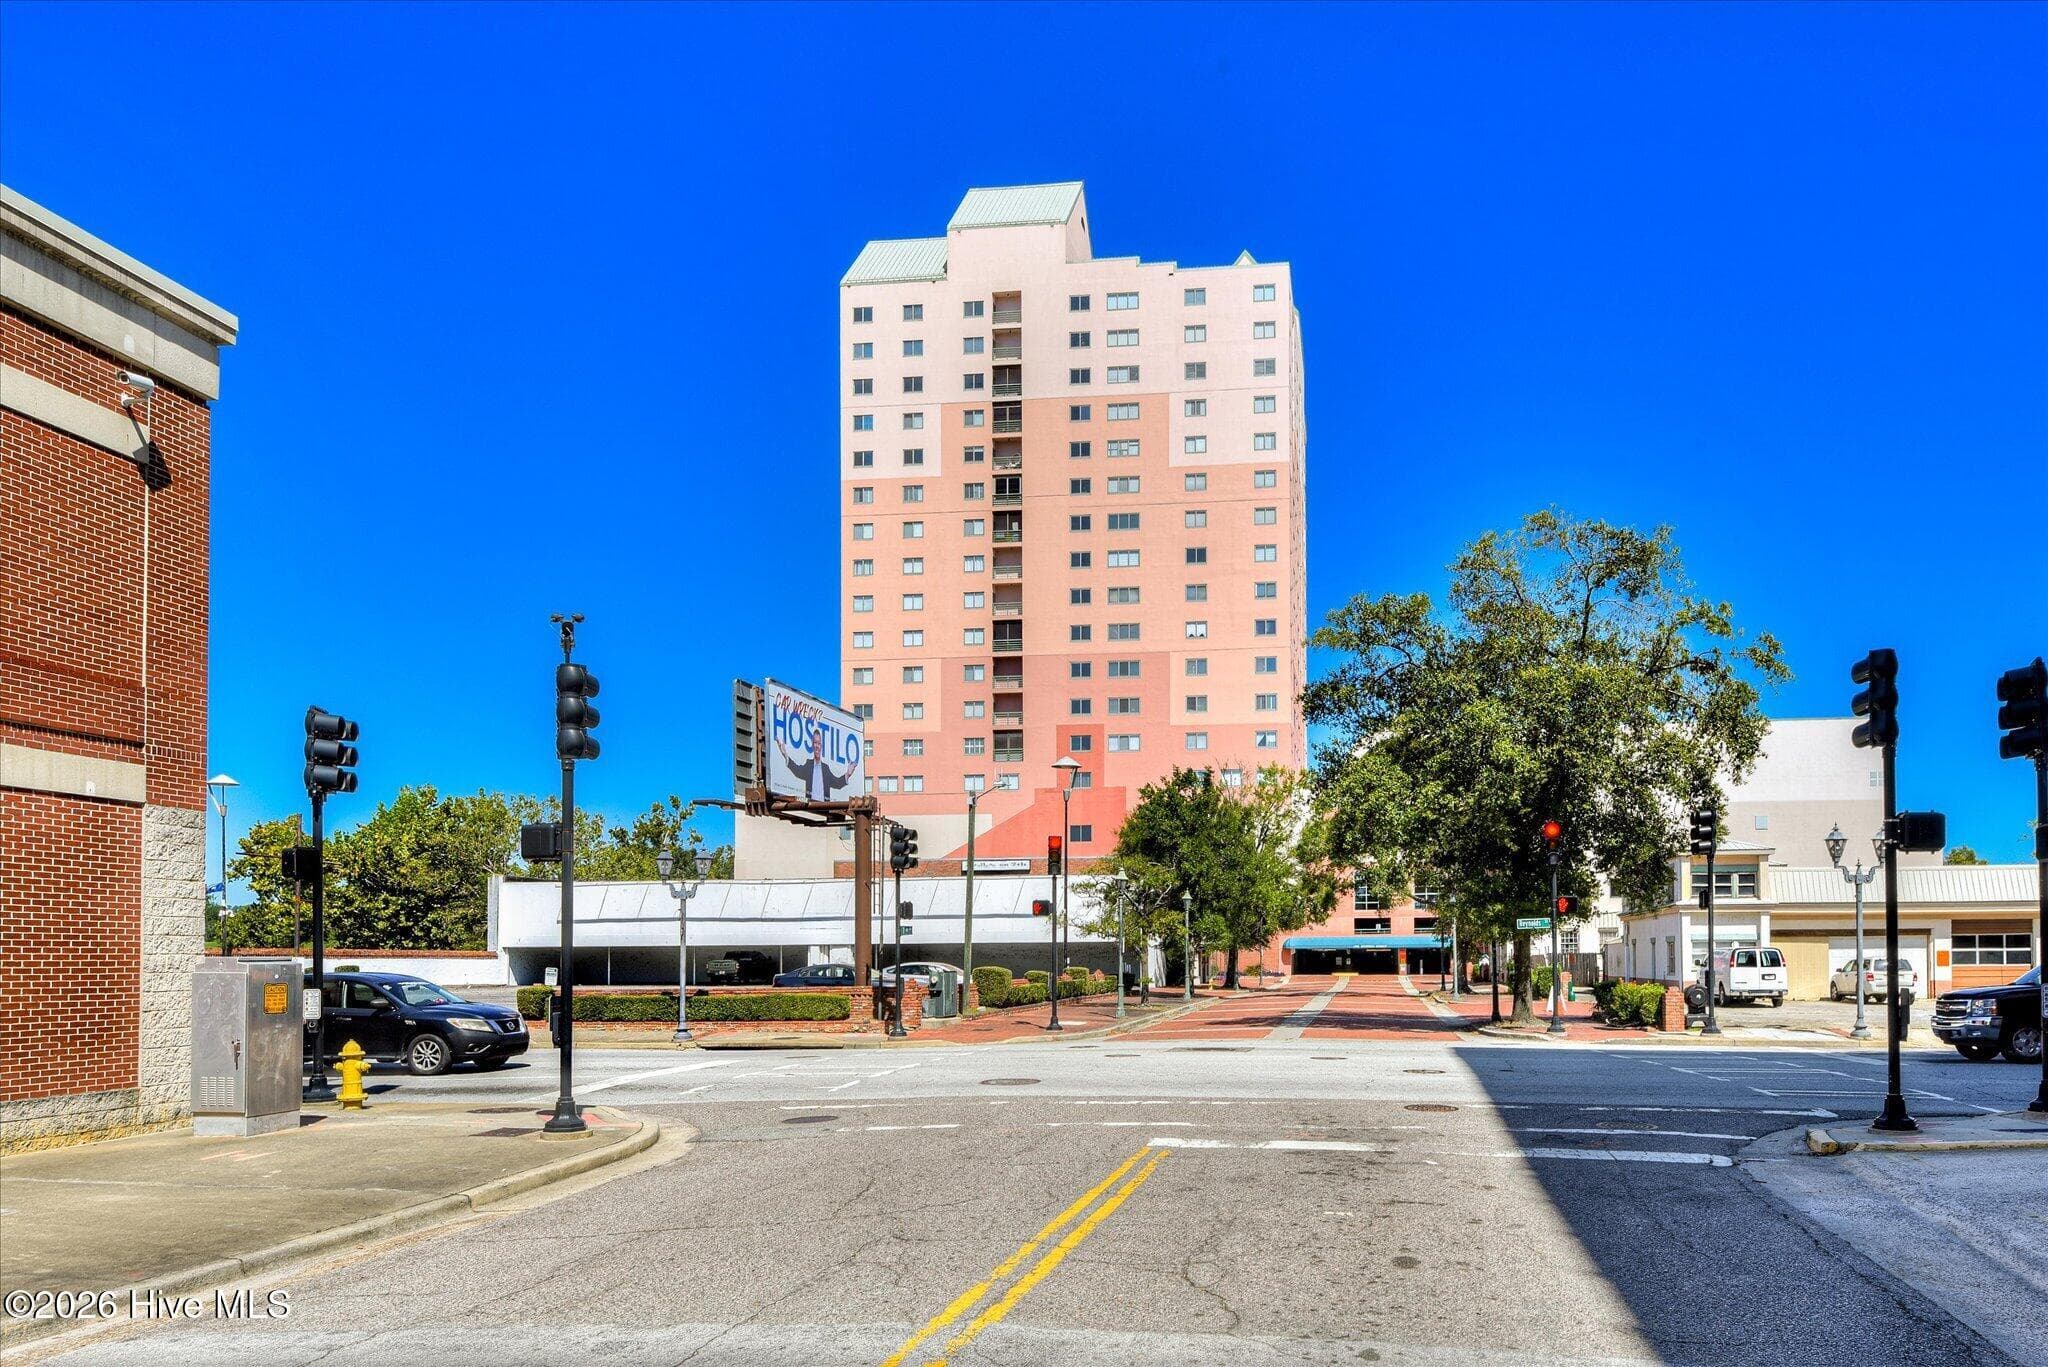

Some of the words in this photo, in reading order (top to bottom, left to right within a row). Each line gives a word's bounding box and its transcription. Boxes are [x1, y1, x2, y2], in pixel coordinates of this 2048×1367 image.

[775, 692, 791, 712] CAR
[773, 703, 859, 765] HOSTILO
[1519, 919, 1541, 928] Reynolds
